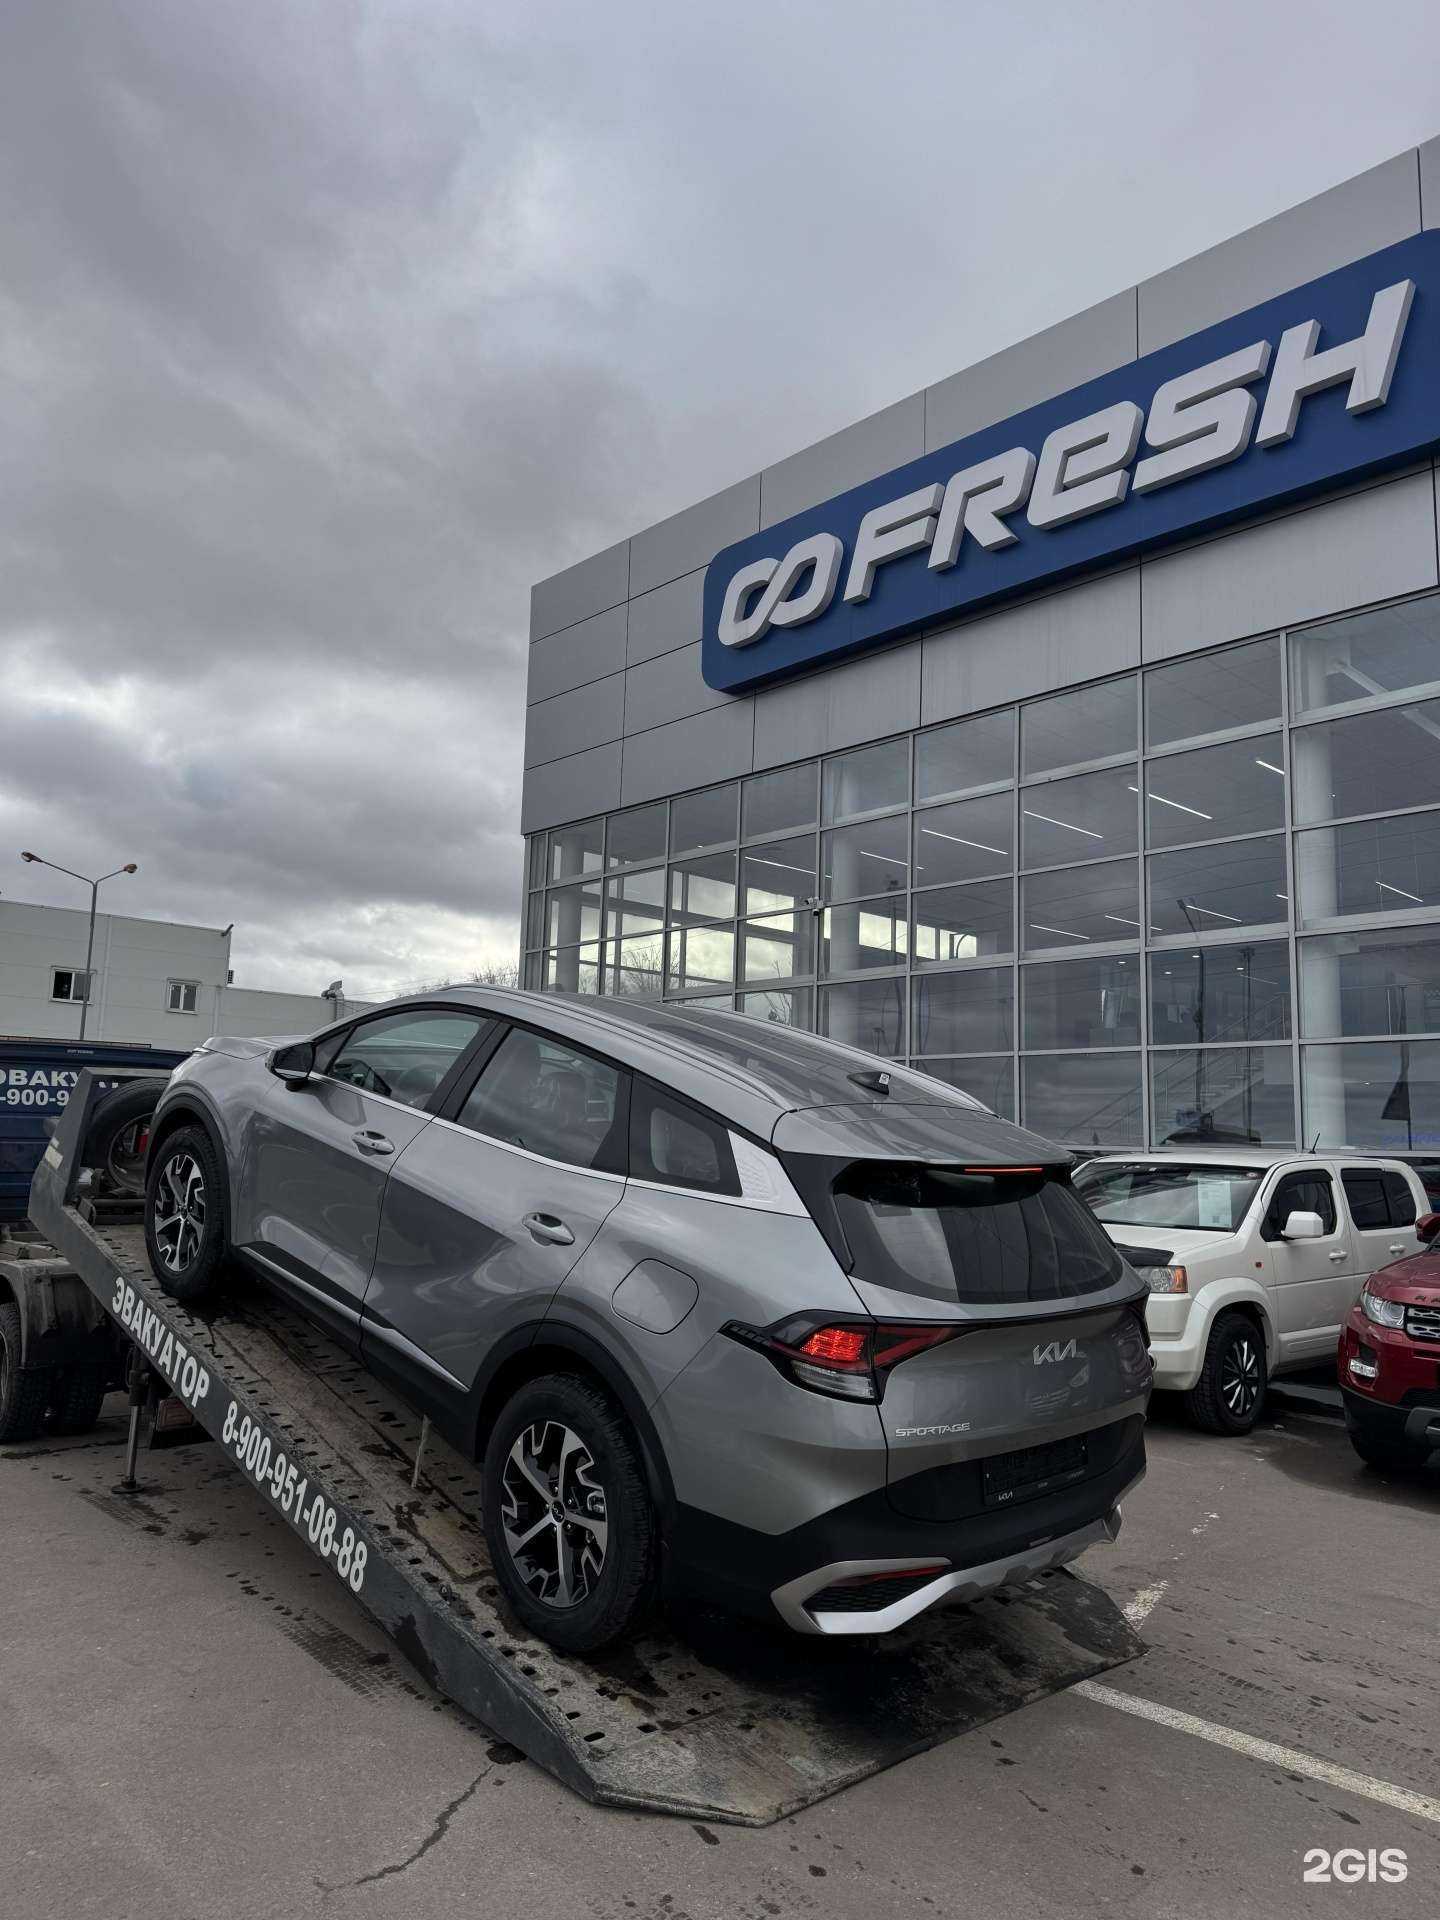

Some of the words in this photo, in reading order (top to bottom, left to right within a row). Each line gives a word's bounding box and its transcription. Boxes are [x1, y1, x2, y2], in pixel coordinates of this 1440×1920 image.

[0, 1069, 80, 1087] ВАКУ
[0, 1088, 70, 1106] -900-9
[1032, 1338, 1077, 1365] KIA
[112, 1277, 210, 1408] ЭВАКУАТОР
[222, 1401, 368, 1592] 8-900-951-08-88
[895, 1422, 971, 1438] SPORTAGE
